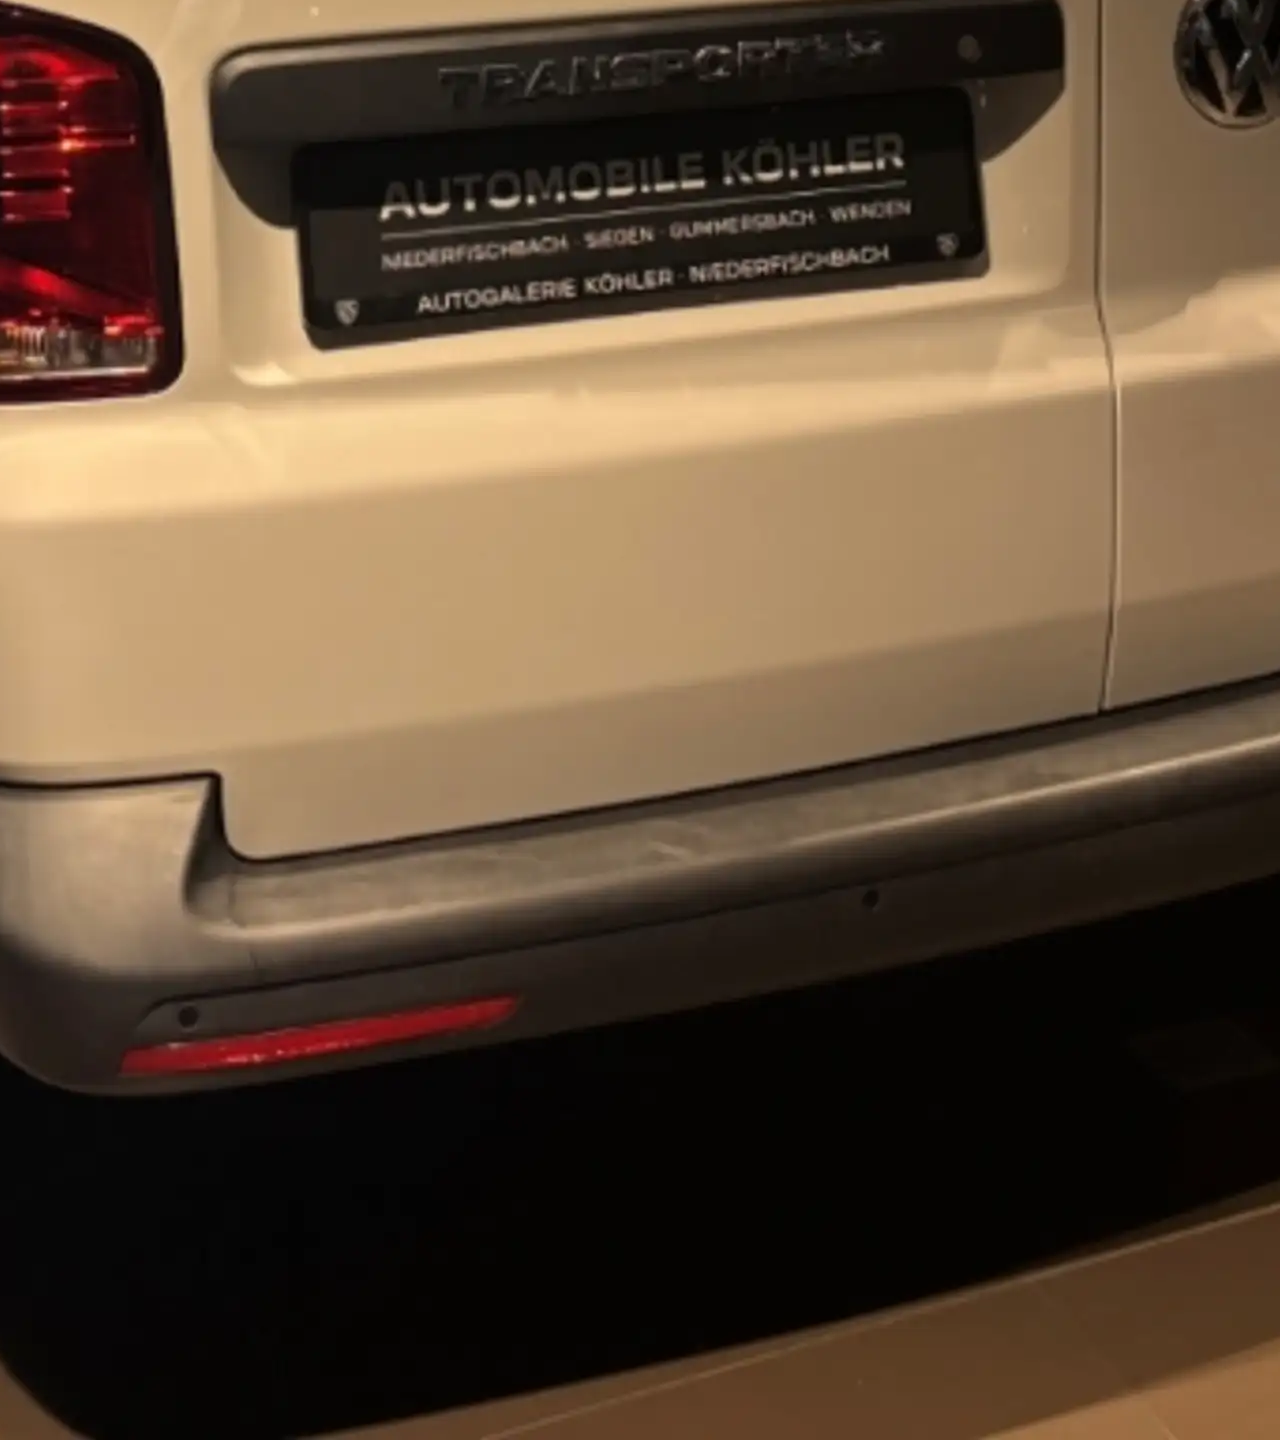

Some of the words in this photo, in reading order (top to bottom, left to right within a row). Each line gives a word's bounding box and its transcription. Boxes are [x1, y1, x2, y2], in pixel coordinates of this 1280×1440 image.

[378, 151, 705, 221] AUTOMOBILE
[722, 133, 905, 186] KÖHLER
[380, 233, 569, 272] NIEDERFISCHBACH
[670, 208, 816, 240] GUMMERSBACH
[829, 199, 912, 223] WENDEN
[417, 276, 577, 314] AUTOGALERIE
[584, 269, 674, 296] KÖHLER
[688, 244, 890, 284] NIEDERFISCHBACH
